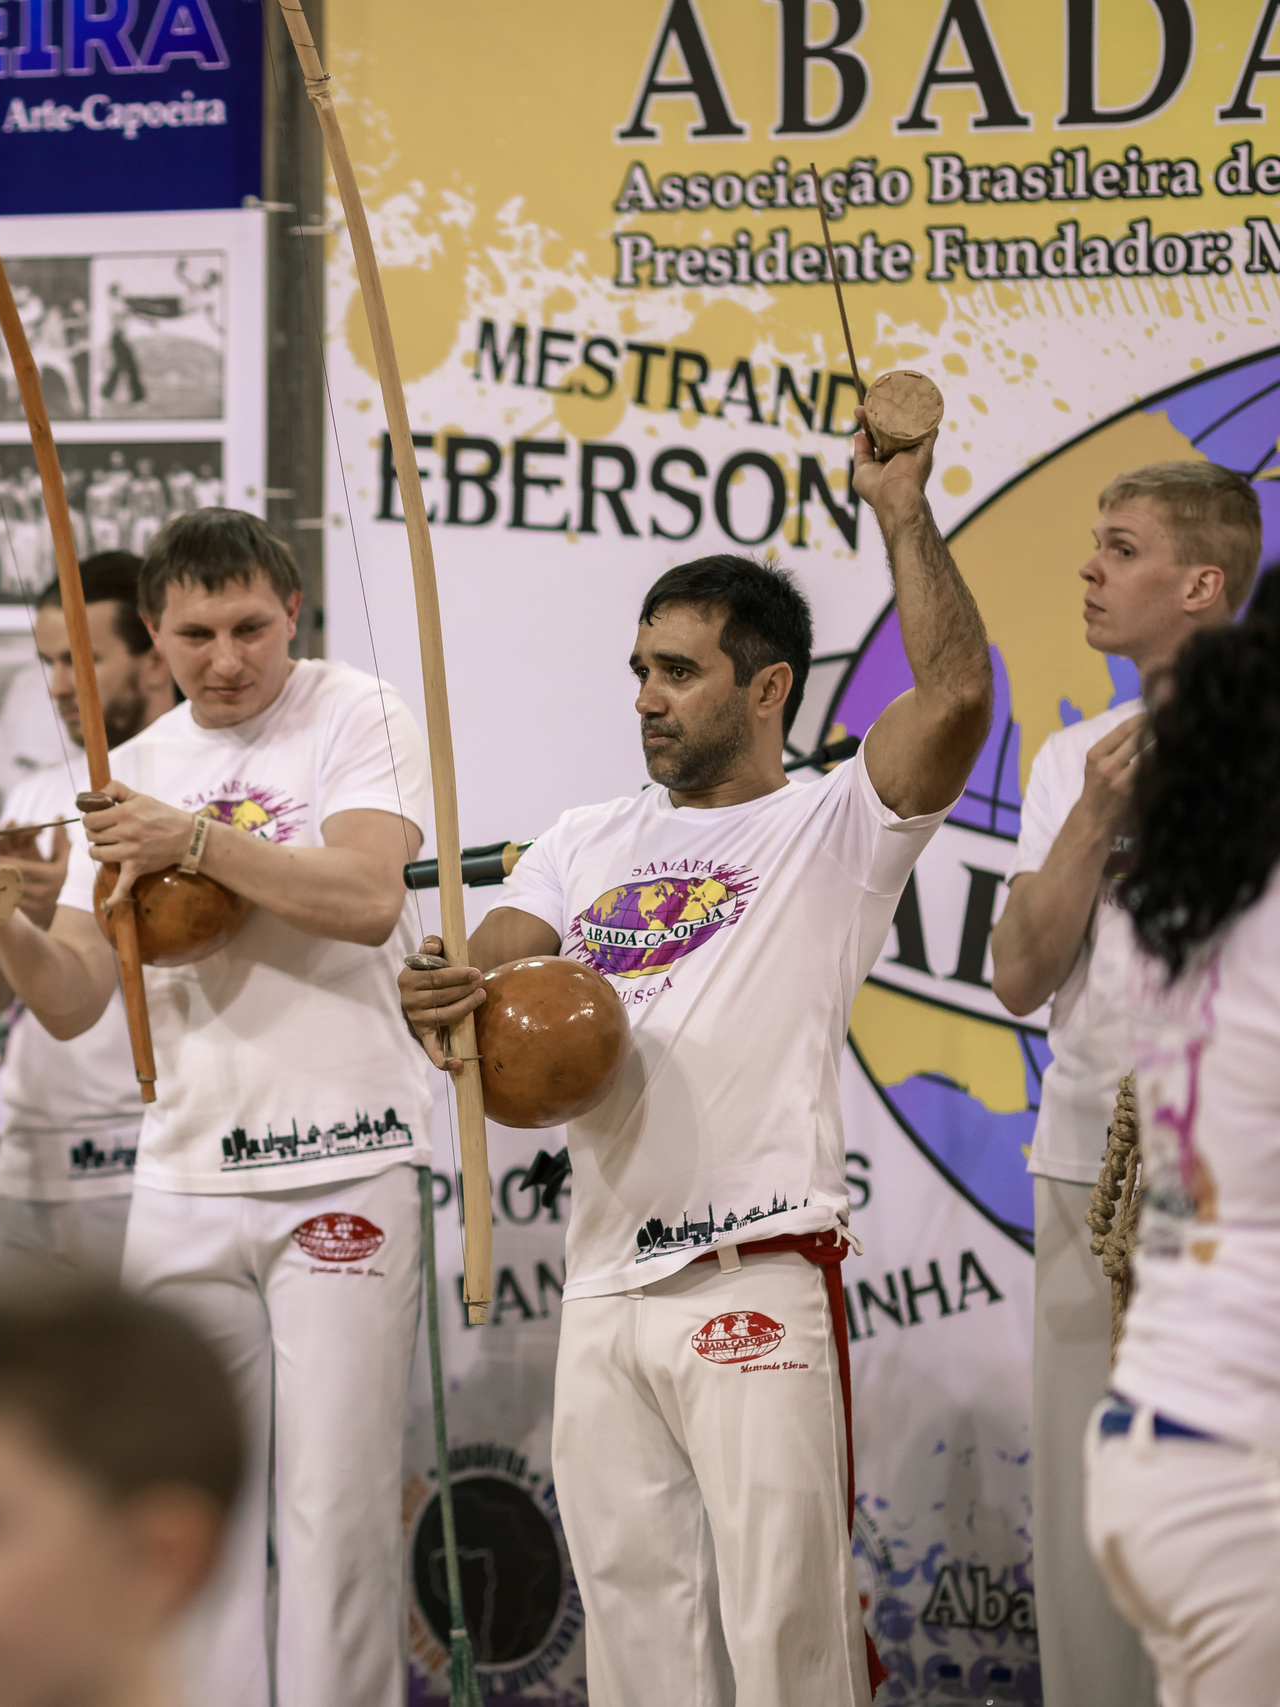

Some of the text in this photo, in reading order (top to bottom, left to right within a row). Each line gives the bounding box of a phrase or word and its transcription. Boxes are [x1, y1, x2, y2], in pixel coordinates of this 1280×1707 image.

[2, 89, 227, 140] Arte-Capoeira
[616, 139, 1280, 222] Associação Brasileira de
[614, 226, 913, 287] Presidente
[926, 217, 1233, 283] Fundador:
[472, 317, 868, 438] MESTRAND
[376, 430, 861, 551] EBERSON
[740, 1360, 809, 1374] Mestrando Eberson
[922, 1565, 1038, 1632] Aba
